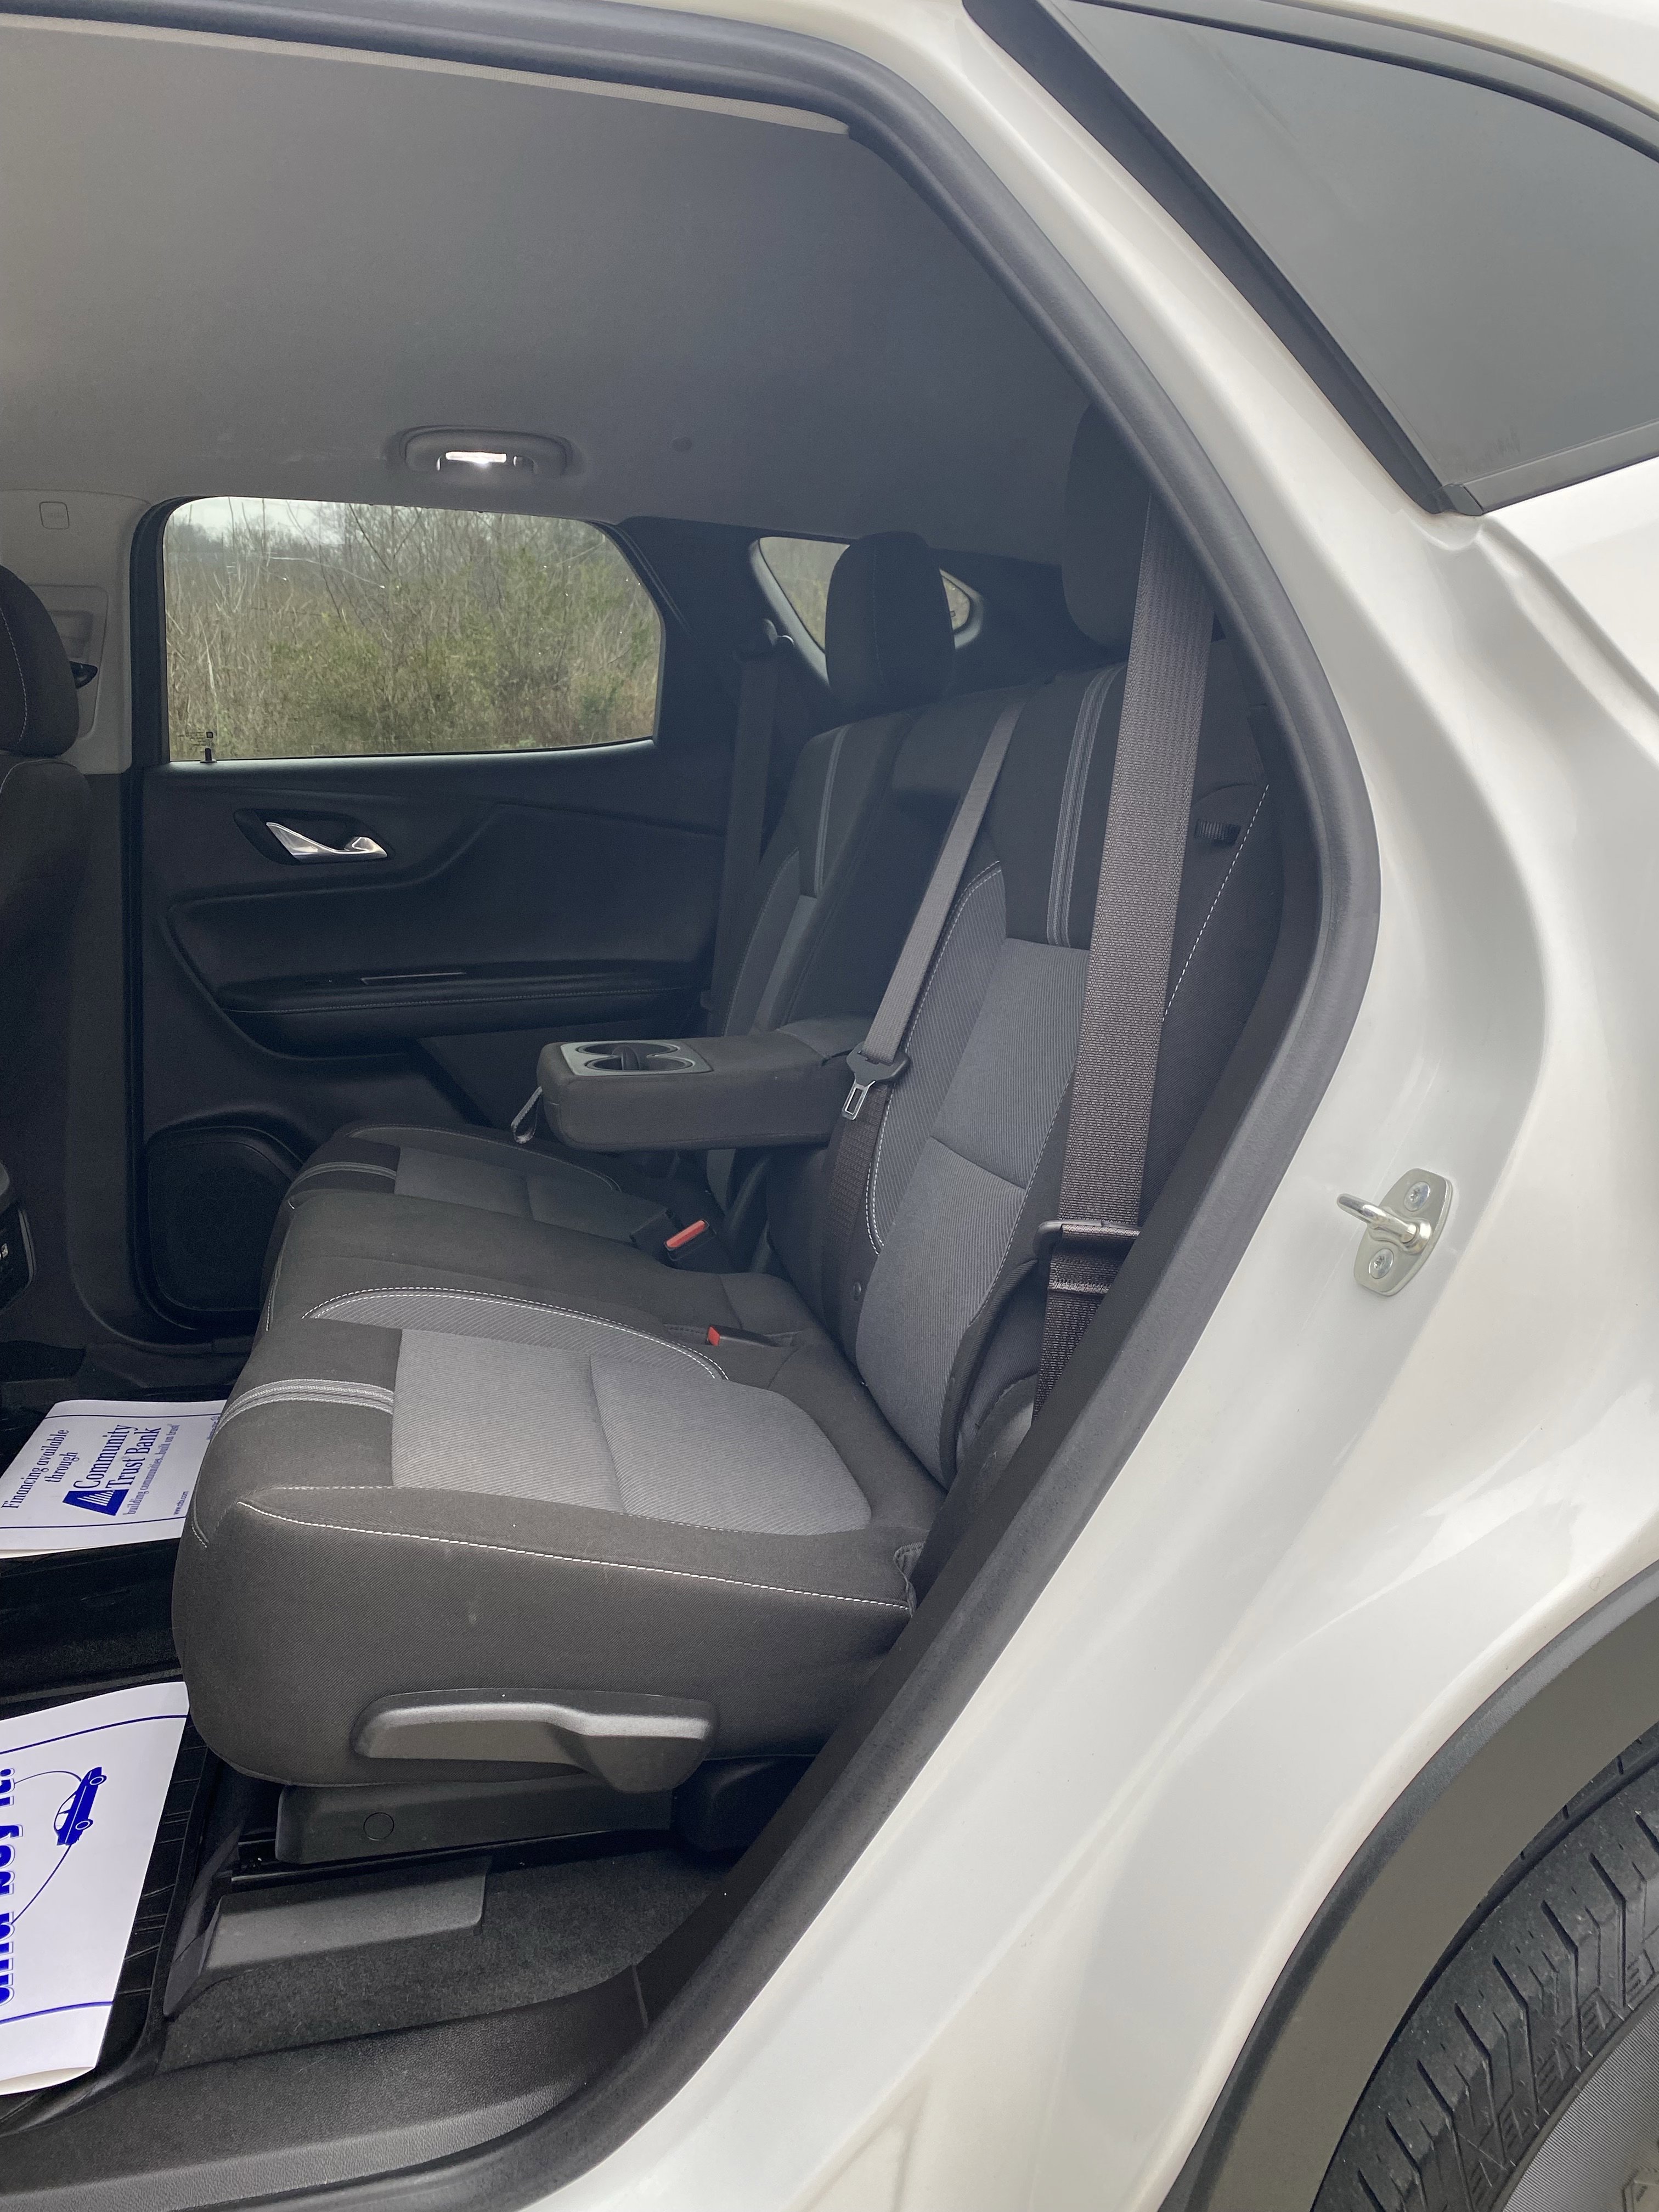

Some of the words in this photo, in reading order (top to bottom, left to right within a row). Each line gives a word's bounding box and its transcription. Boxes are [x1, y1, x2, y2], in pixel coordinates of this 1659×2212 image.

[125, 1427, 161, 1454] Bank
[1, 1468, 48, 1508] Financing
[37, 1430, 69, 1465] available
[44, 1453, 80, 1482] through
[74, 1425, 139, 1488] Community
[123, 1491, 149, 1515] building
